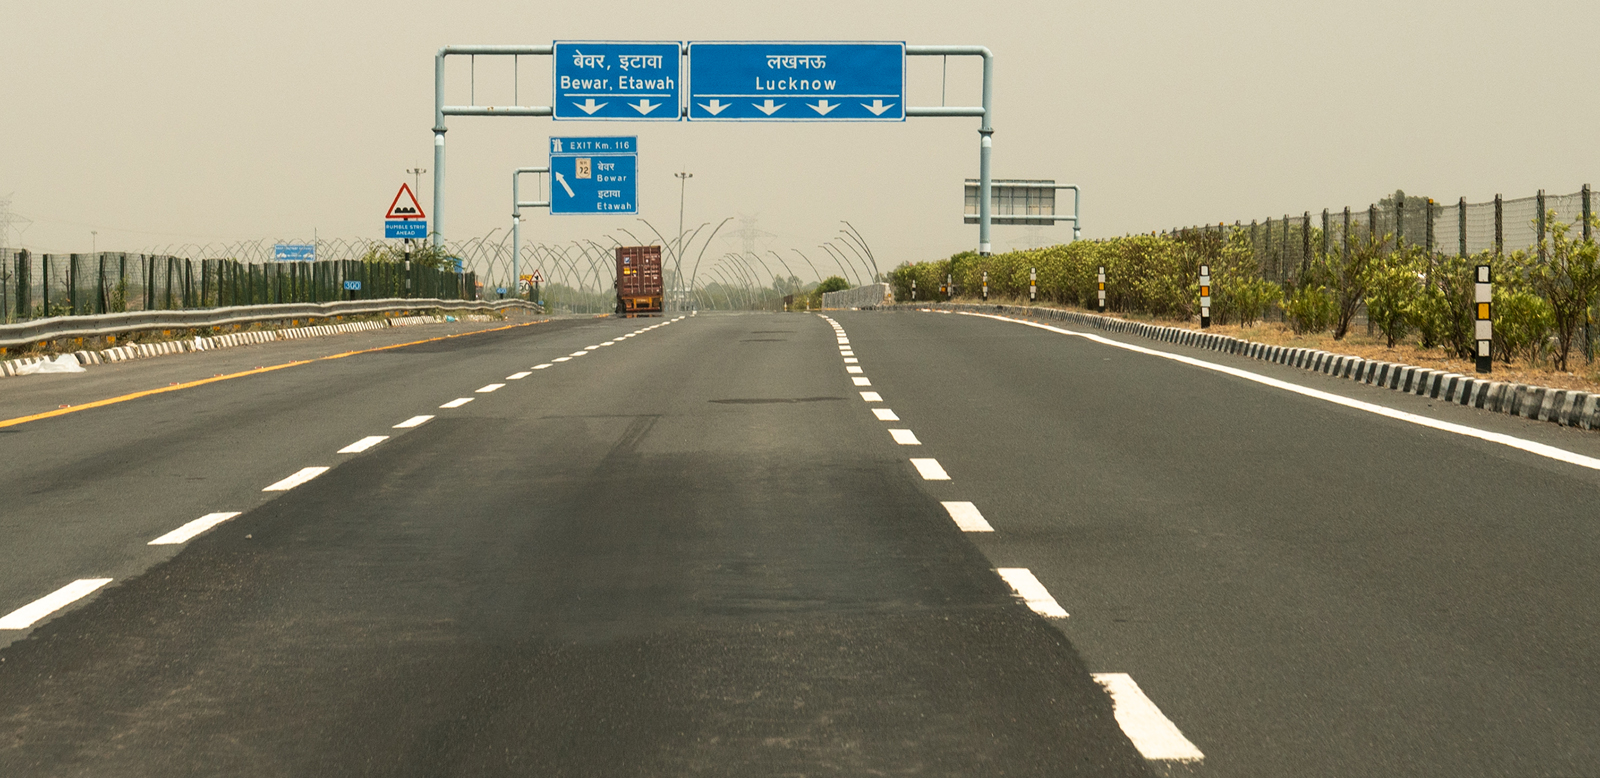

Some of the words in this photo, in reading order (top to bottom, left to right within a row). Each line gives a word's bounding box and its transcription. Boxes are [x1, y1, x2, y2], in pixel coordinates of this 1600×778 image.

[572, 49, 611, 70] बेवर,
[618, 54, 663, 71] इटावा
[766, 55, 826, 69] लखनऊ
[560, 75, 613, 91] Bewar,
[619, 75, 674, 90] Etawah
[756, 76, 836, 90] Lucknow
[570, 141, 592, 150] EXIT
[595, 141, 612, 150] Km.
[615, 141, 630, 150] 116
[597, 174, 627, 182] Bewar
[597, 190, 621, 199] इटावा
[597, 202, 632, 210] Etawah
[344, 282, 360, 290] 300
